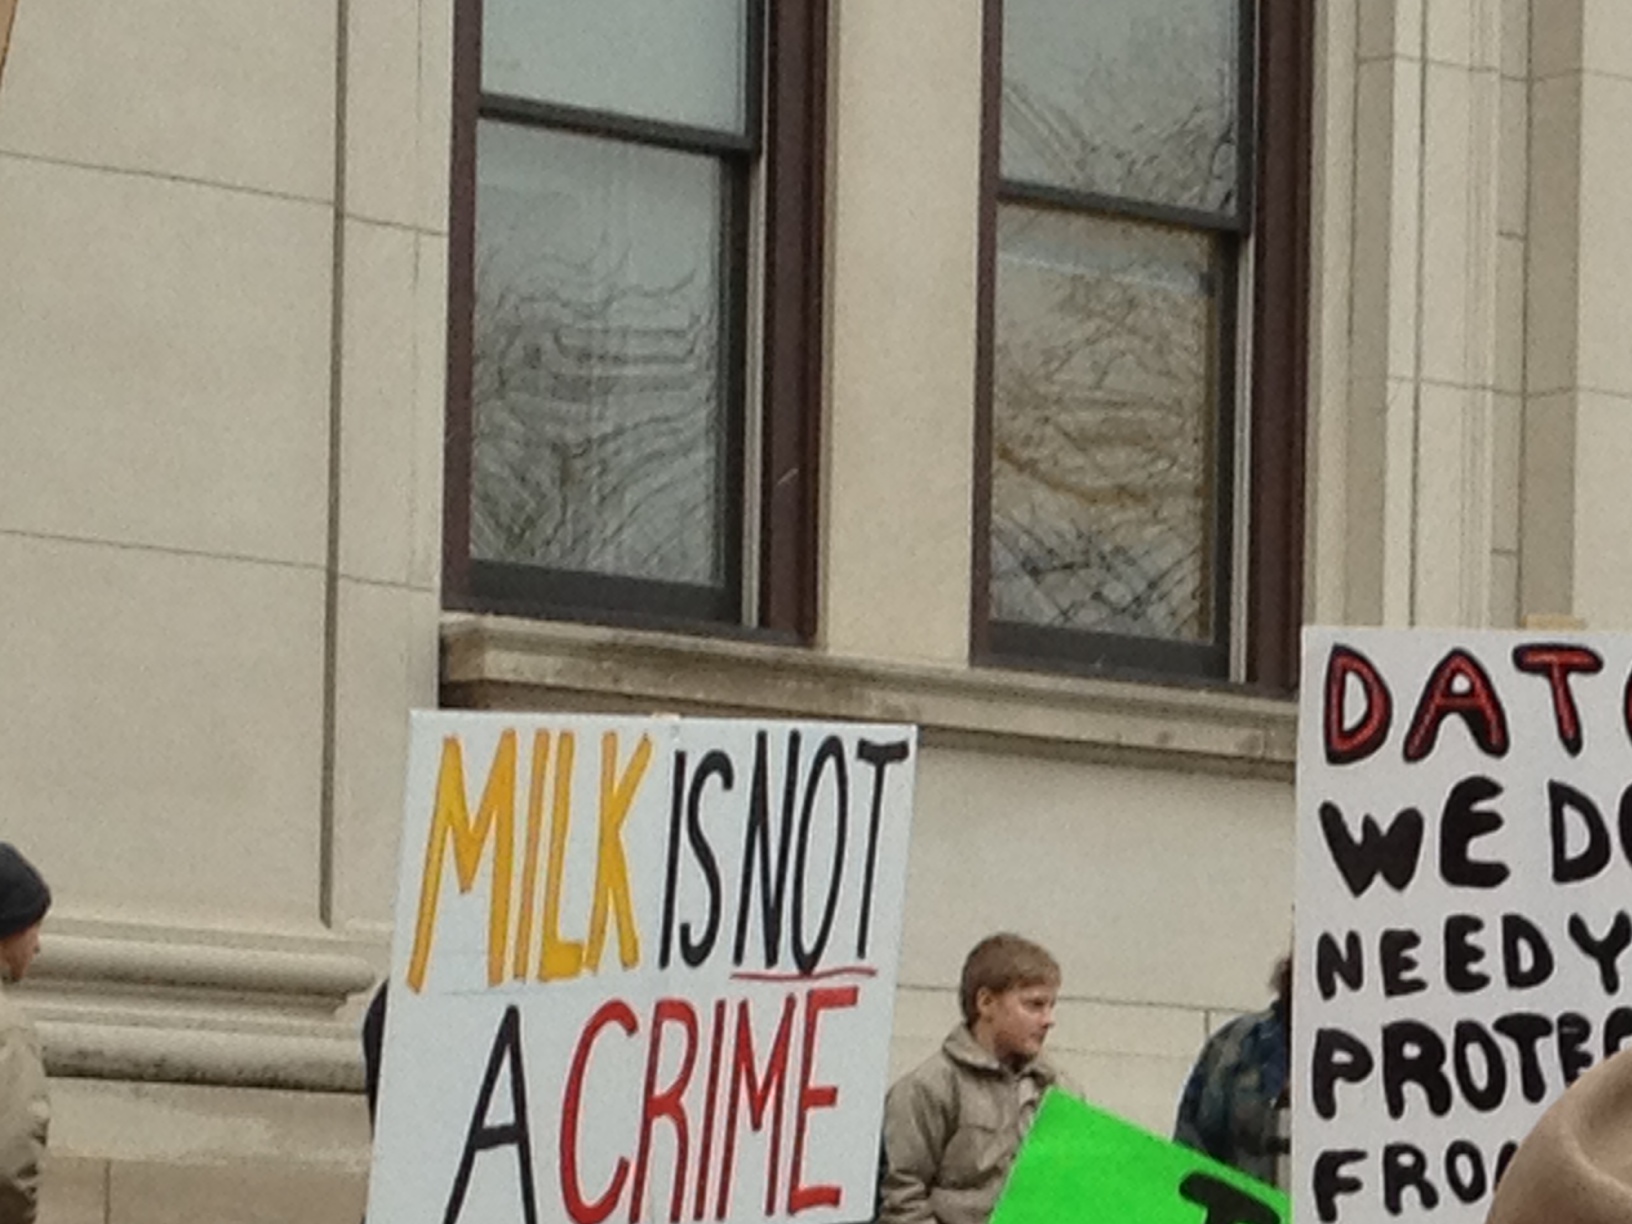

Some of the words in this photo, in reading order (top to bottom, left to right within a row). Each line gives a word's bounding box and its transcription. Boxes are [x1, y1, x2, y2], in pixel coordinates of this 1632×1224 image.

[407, 728, 652, 994] MILK
[659, 749, 734, 970] IS
[733, 729, 909, 975] NOT
[1319, 776, 1510, 898] WE
[1316, 913, 1554, 1000] NEED
[1313, 1139, 1518, 1224] FRO
